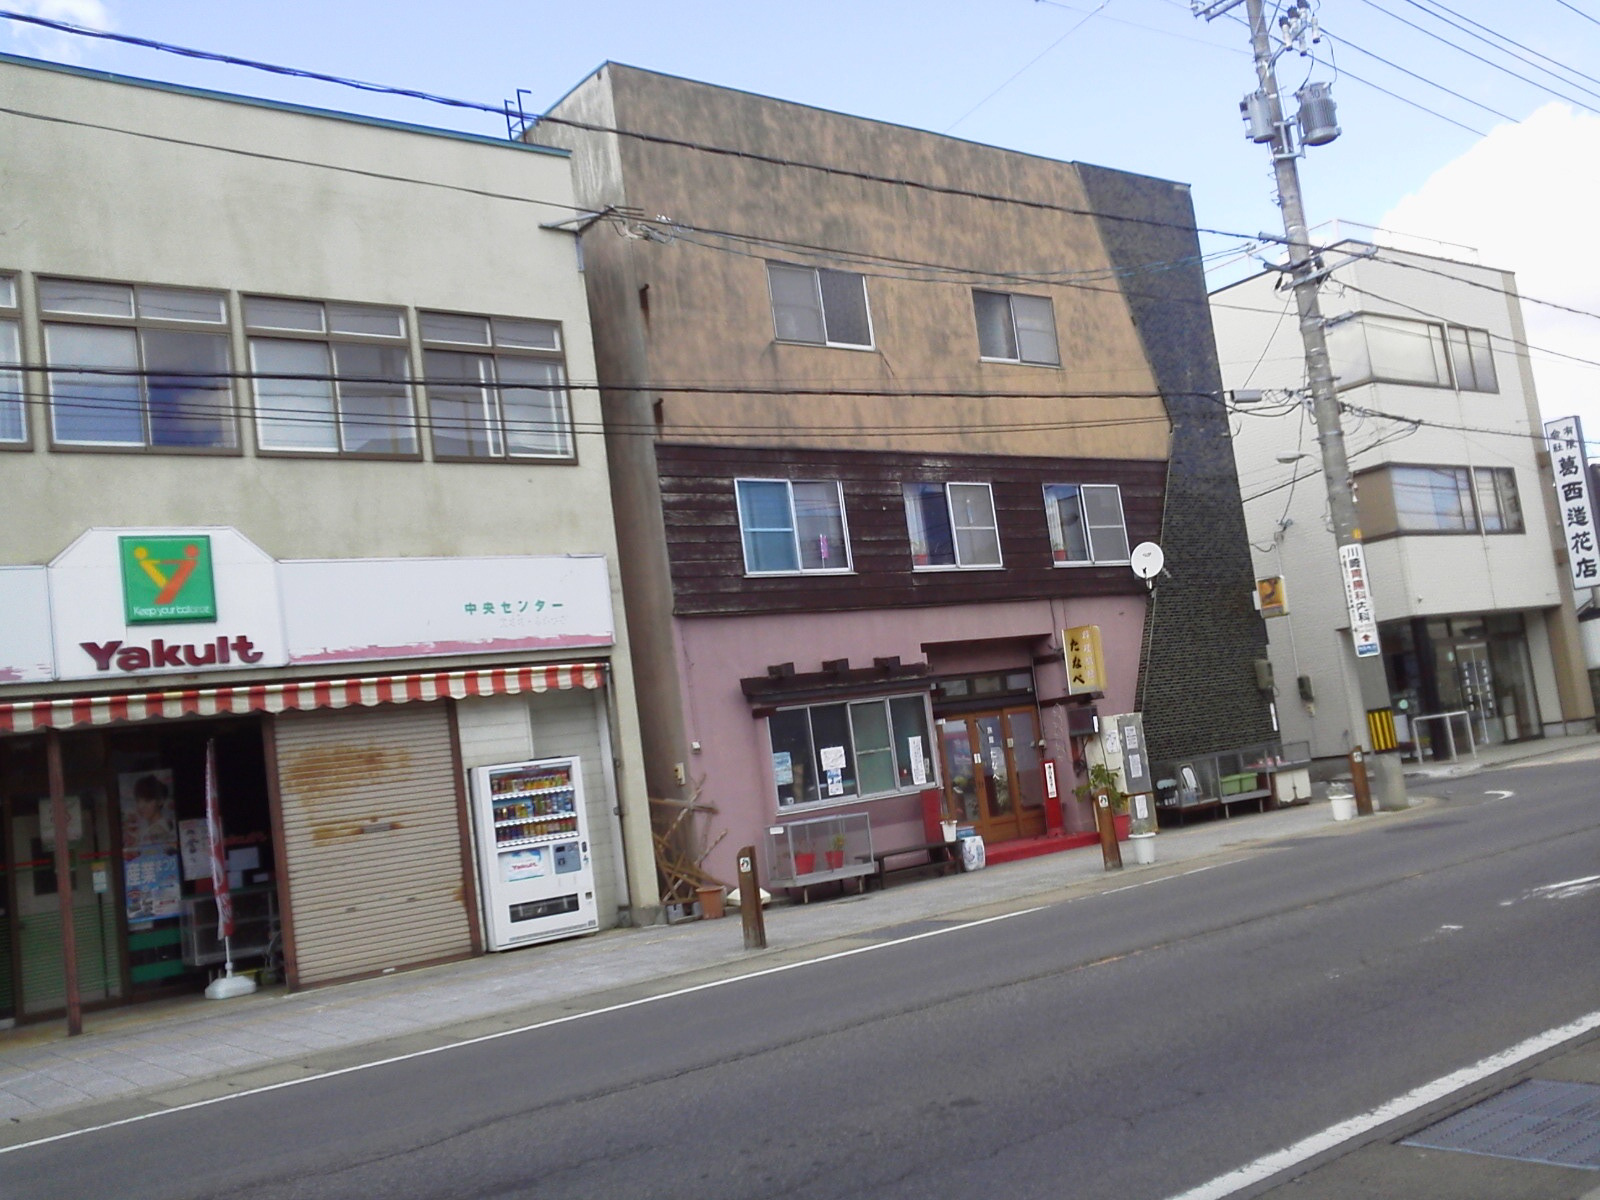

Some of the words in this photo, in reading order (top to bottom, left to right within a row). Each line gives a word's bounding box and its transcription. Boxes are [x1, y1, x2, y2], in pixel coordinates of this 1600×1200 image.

[1558, 455, 1597, 579] 葛西造花店
[133, 606, 157, 617] Keep
[157, 606, 176, 617] your
[464, 600, 564, 615] 中央センター
[79, 635, 264, 672] Yakult
[1069, 638, 1085, 685] たなべ
